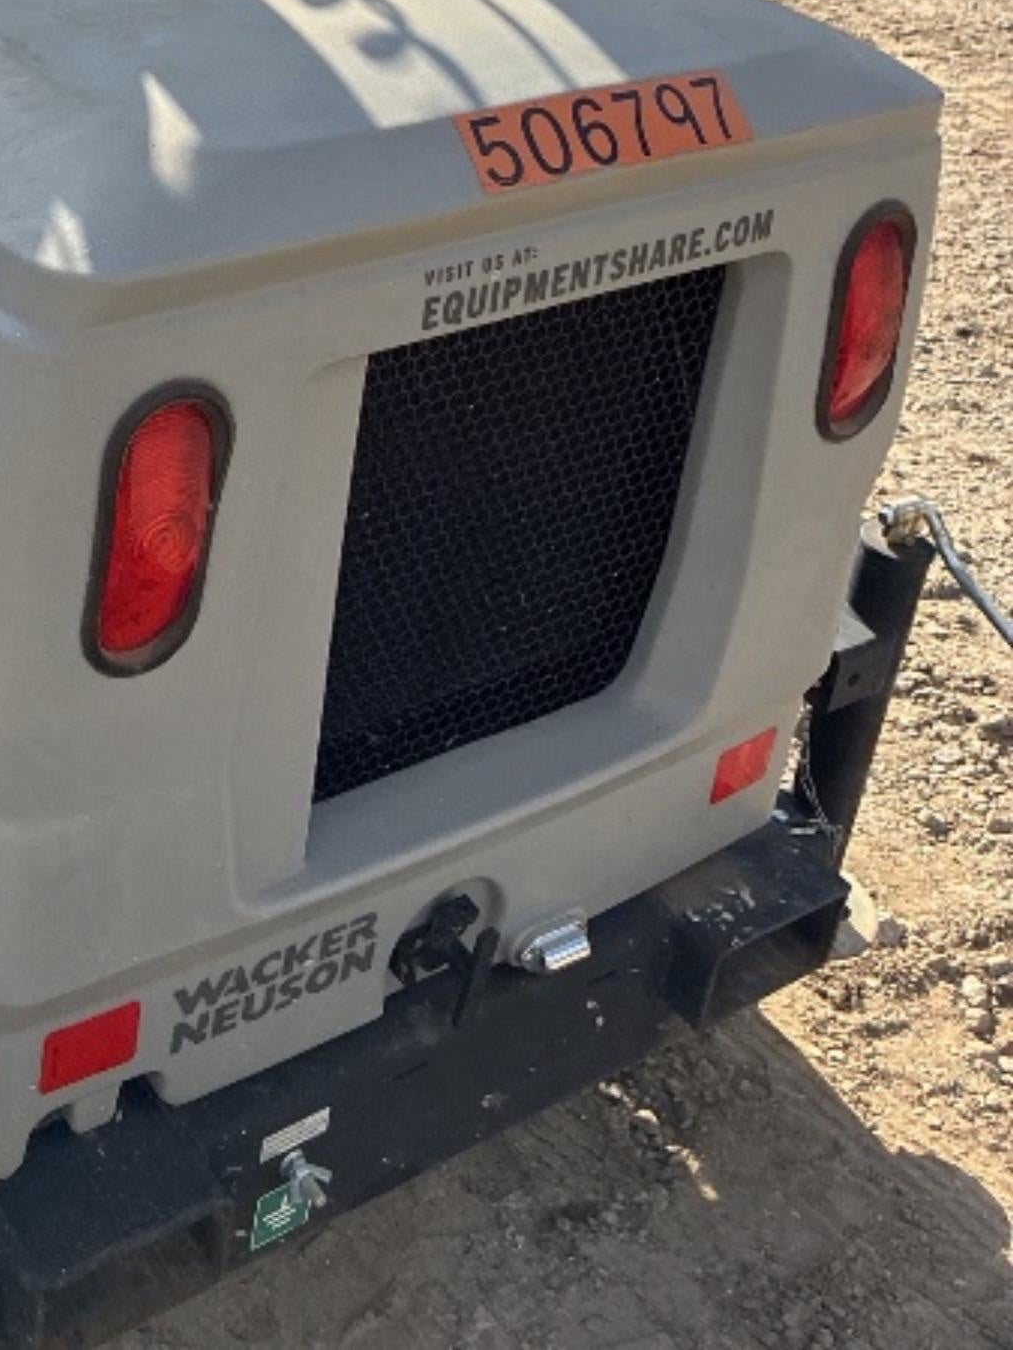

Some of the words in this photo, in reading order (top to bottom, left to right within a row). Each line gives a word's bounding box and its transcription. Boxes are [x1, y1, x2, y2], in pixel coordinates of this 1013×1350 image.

[469, 77, 732, 187] 506797
[421, 209, 775, 331] EQUIPMENTSHARE.COM
[424, 260, 474, 286] VISIT
[169, 941, 377, 1055] NEUSON
[173, 911, 379, 1015] WACKER
